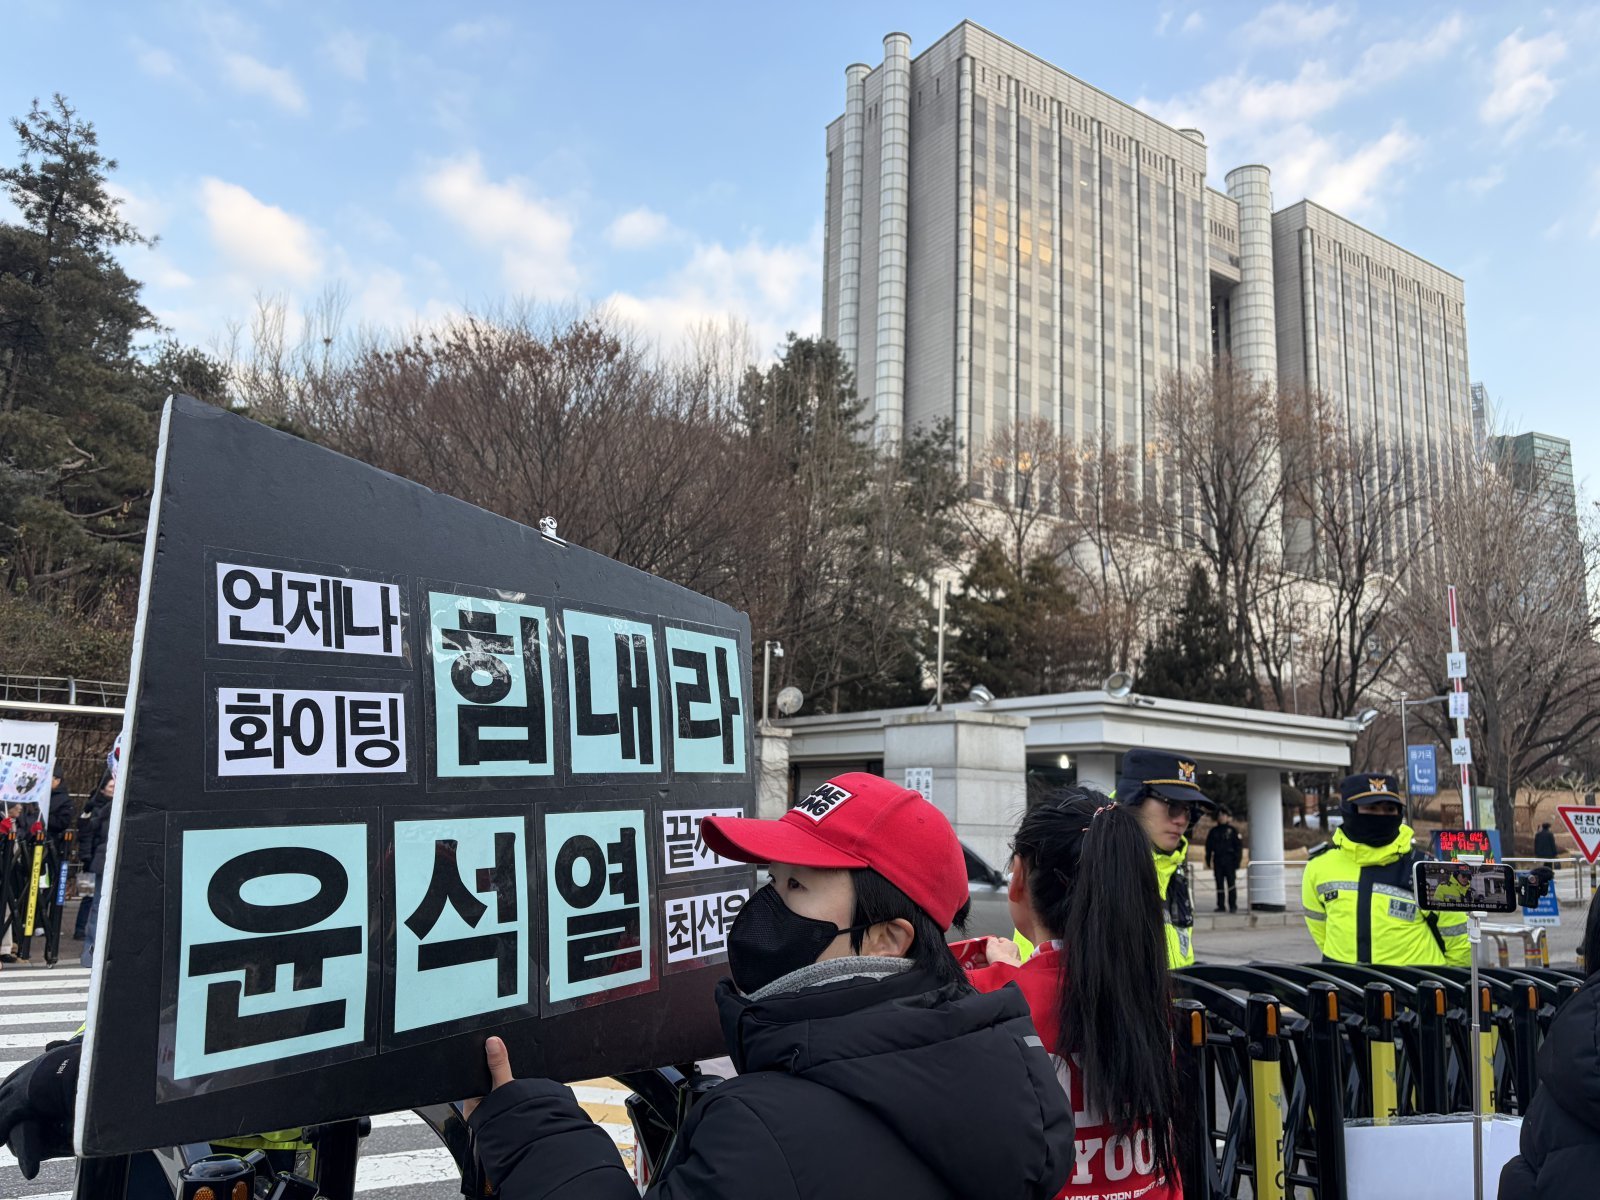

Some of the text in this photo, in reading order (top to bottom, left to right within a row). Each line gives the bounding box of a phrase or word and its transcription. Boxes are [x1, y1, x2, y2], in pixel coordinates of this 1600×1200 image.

[222, 569, 399, 654] 언제나
[224, 692, 400, 769] 화이팅
[441, 609, 740, 766] 힘내라
[188, 827, 644, 1056] 윤석열
